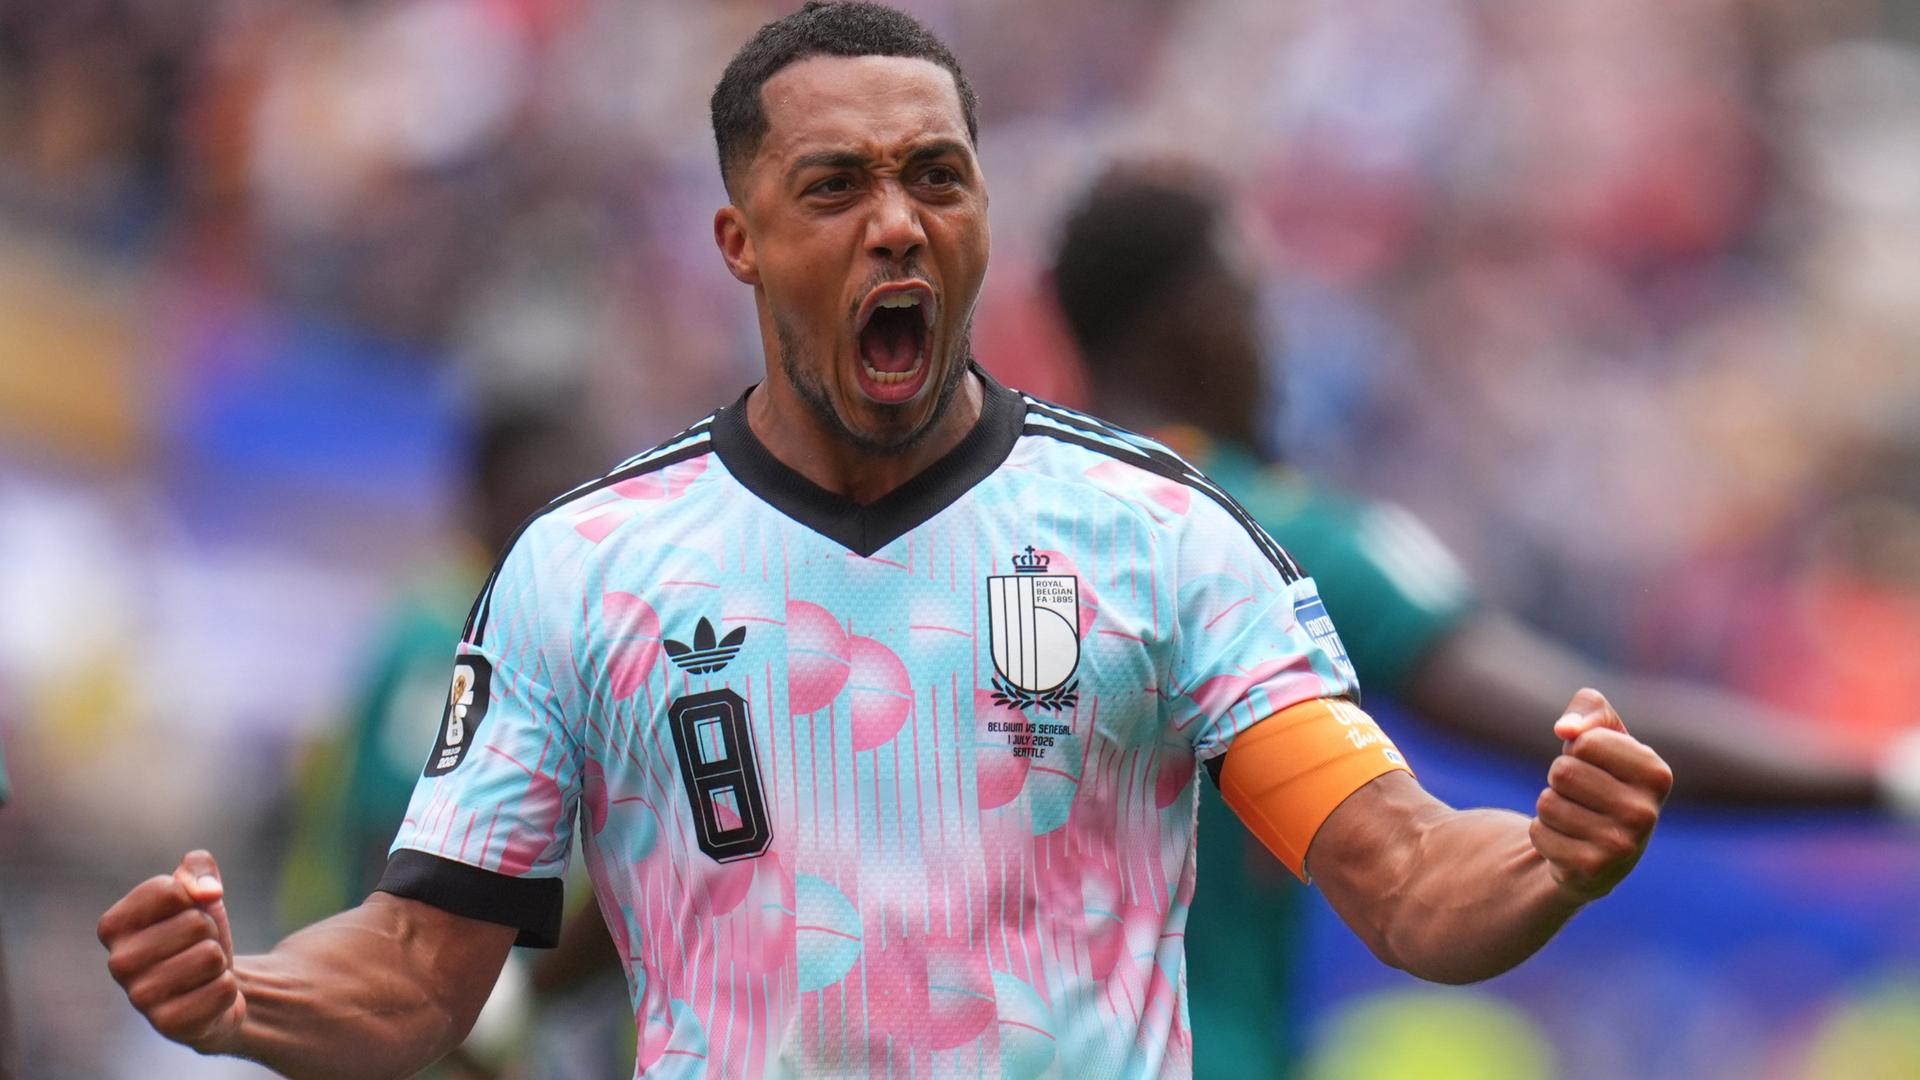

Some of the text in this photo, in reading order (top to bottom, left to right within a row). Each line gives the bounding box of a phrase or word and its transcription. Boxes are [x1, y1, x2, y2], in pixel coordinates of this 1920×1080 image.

[1036, 580, 1064, 588] ROYAL
[987, 721, 1072, 736] BELGIUM VS SENEGAL
[1012, 734, 1031, 746] JULY
[1032, 735, 1055, 747] 2026
[1012, 746, 1046, 758] SEATTLE
[667, 688, 774, 865] 8
